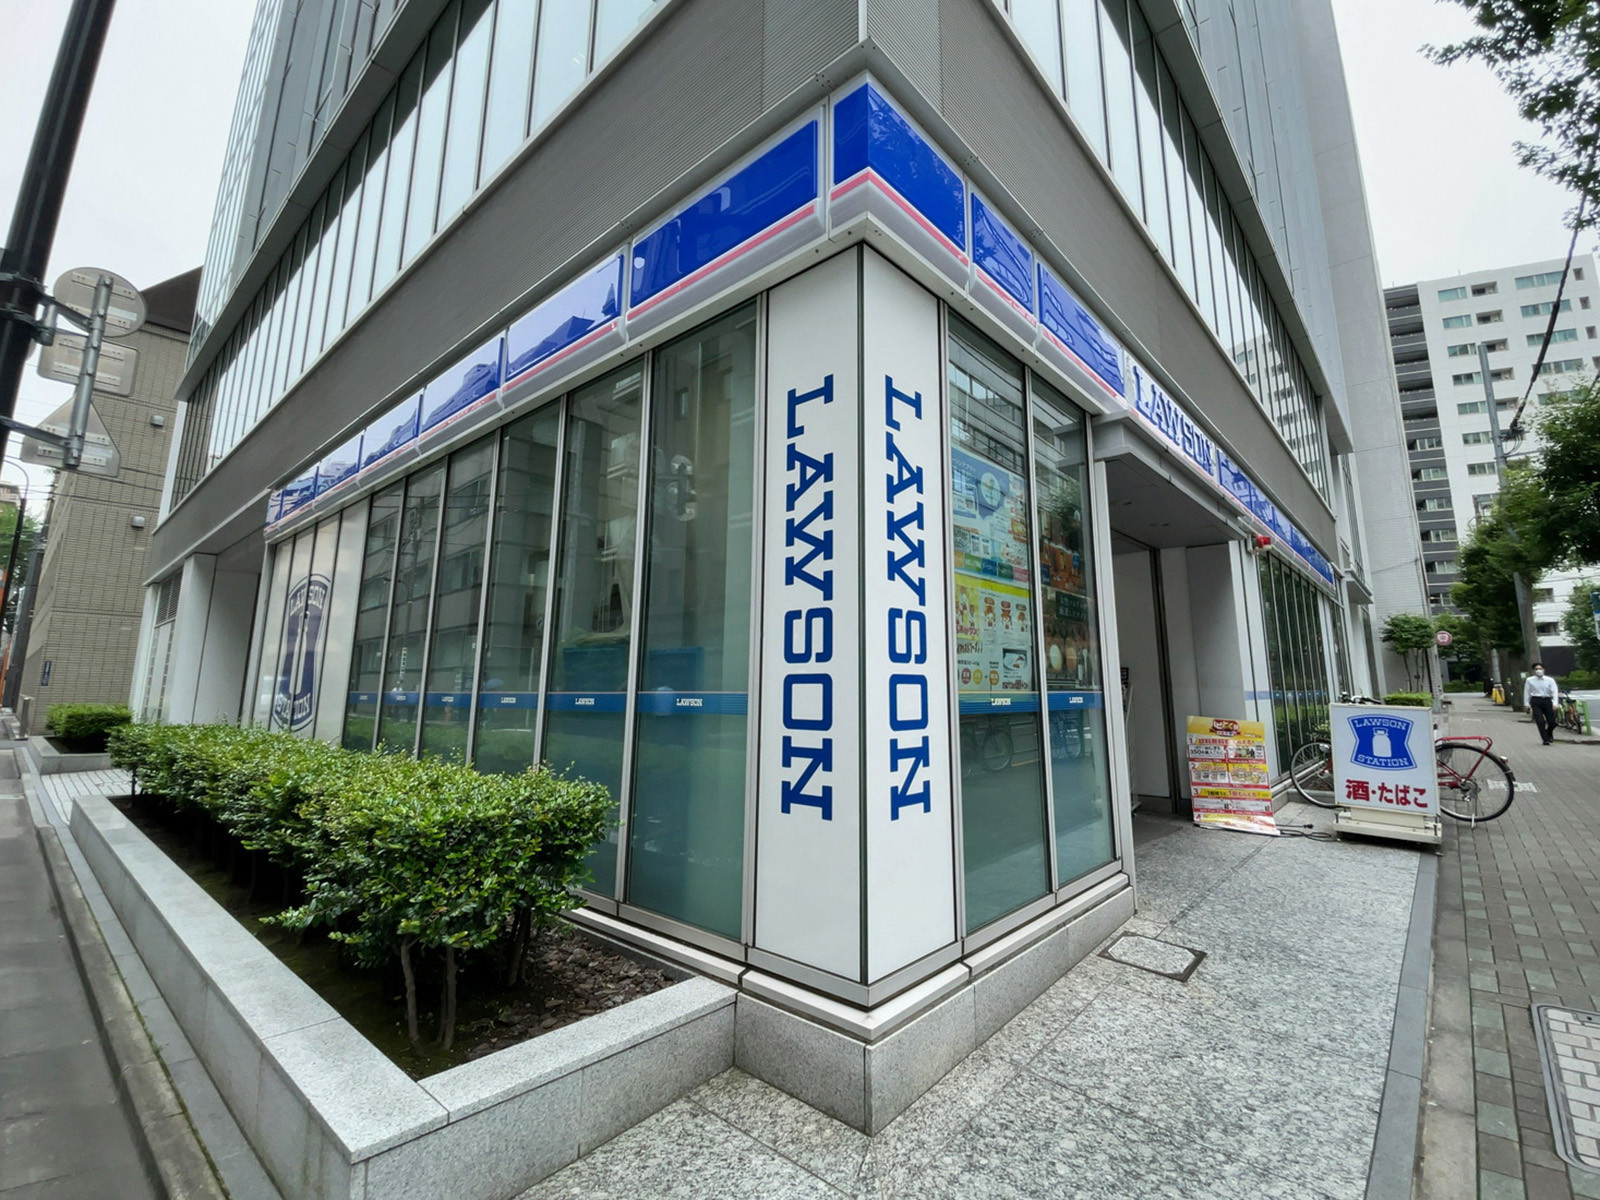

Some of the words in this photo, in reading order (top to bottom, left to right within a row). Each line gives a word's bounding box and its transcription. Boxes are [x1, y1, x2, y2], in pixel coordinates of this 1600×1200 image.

[1133, 366, 1214, 476] LAWSON
[781, 374, 834, 821] LAWSON
[885, 374, 931, 821] LAWSON
[676, 698, 702, 706] LAWSON
[1354, 718, 1407, 731] LAWSON
[1357, 754, 1410, 767] STATION
[1345, 779, 1428, 808] 酒・たばこ
